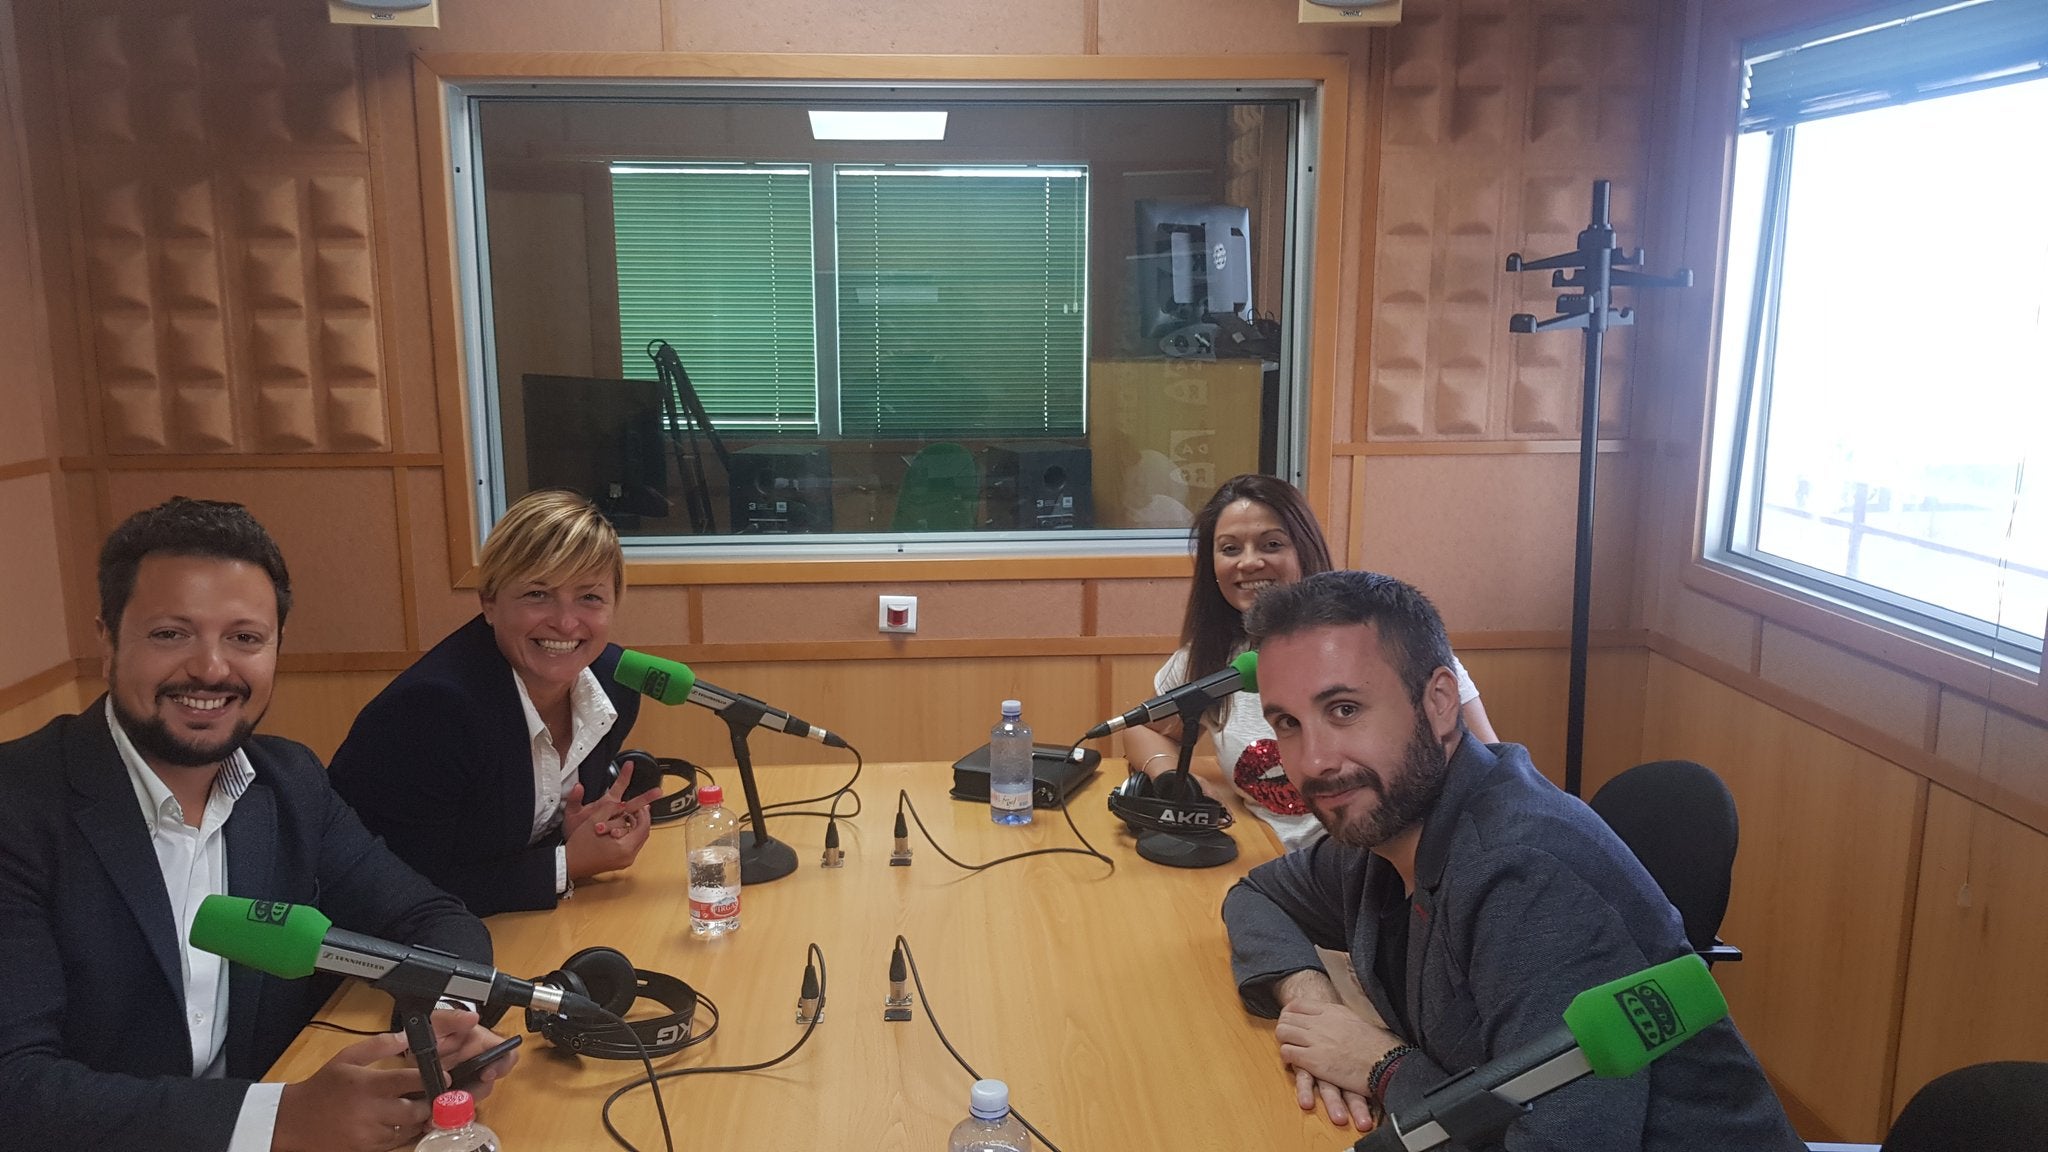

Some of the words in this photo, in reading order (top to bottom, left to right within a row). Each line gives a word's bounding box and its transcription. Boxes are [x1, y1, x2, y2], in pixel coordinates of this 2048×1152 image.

[670, 789, 696, 813] KG
[1157, 809, 1209, 825] AKG
[1627, 997, 1658, 1039] CERO
[656, 1018, 692, 1045] KG
